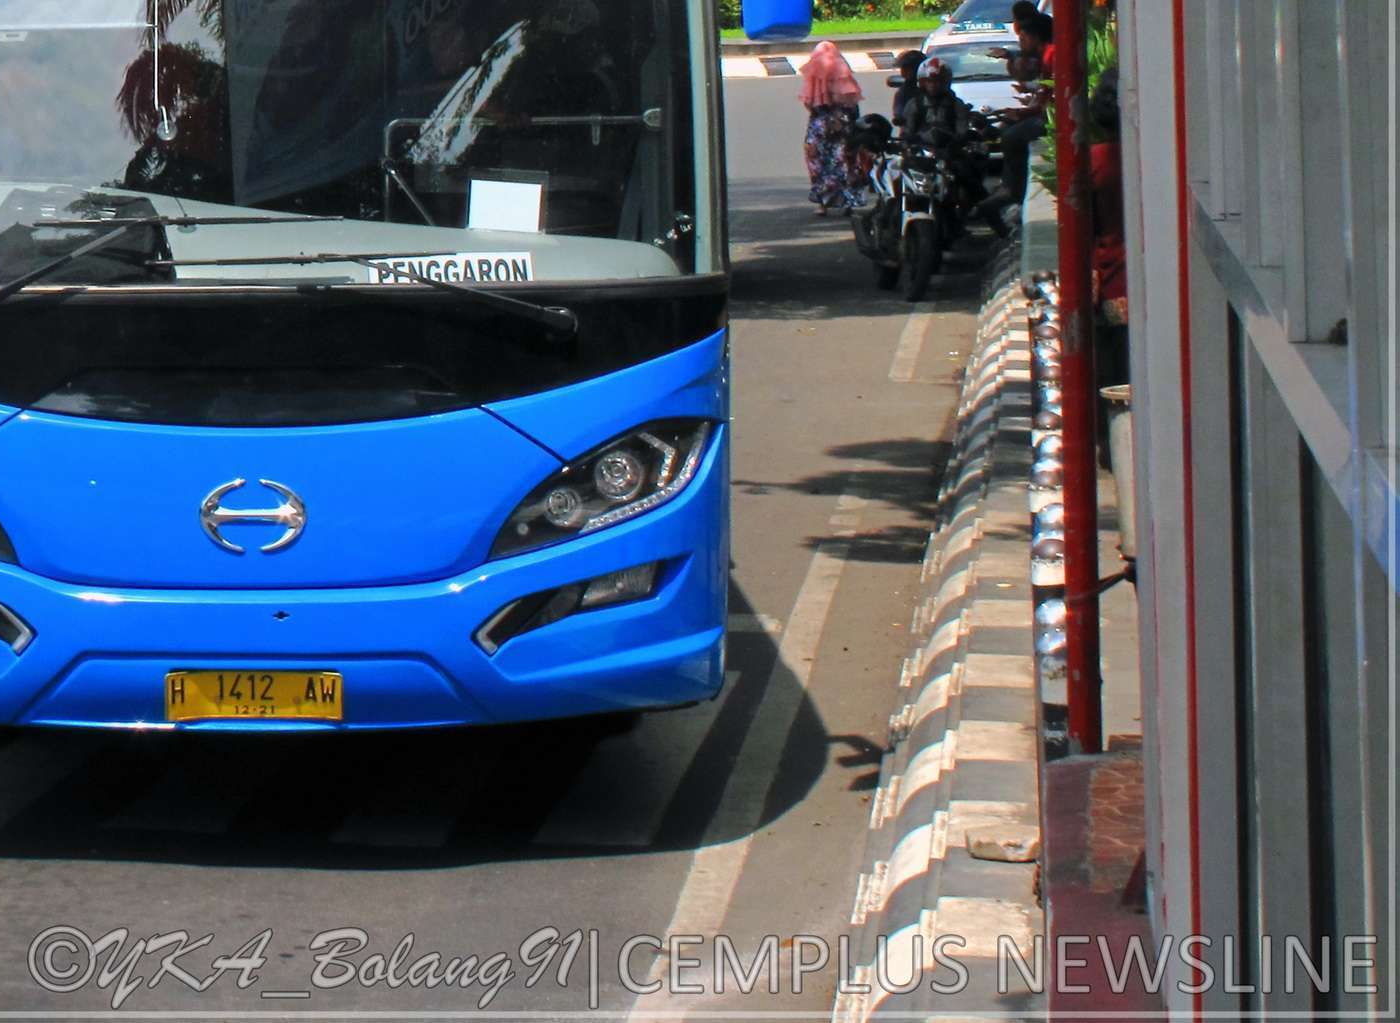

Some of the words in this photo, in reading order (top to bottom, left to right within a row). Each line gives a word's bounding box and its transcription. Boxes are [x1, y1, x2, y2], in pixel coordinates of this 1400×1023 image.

[377, 259, 528, 284] PENGGARON
[171, 677, 185, 704] H
[217, 675, 274, 701] 1412
[305, 677, 336, 704] AW
